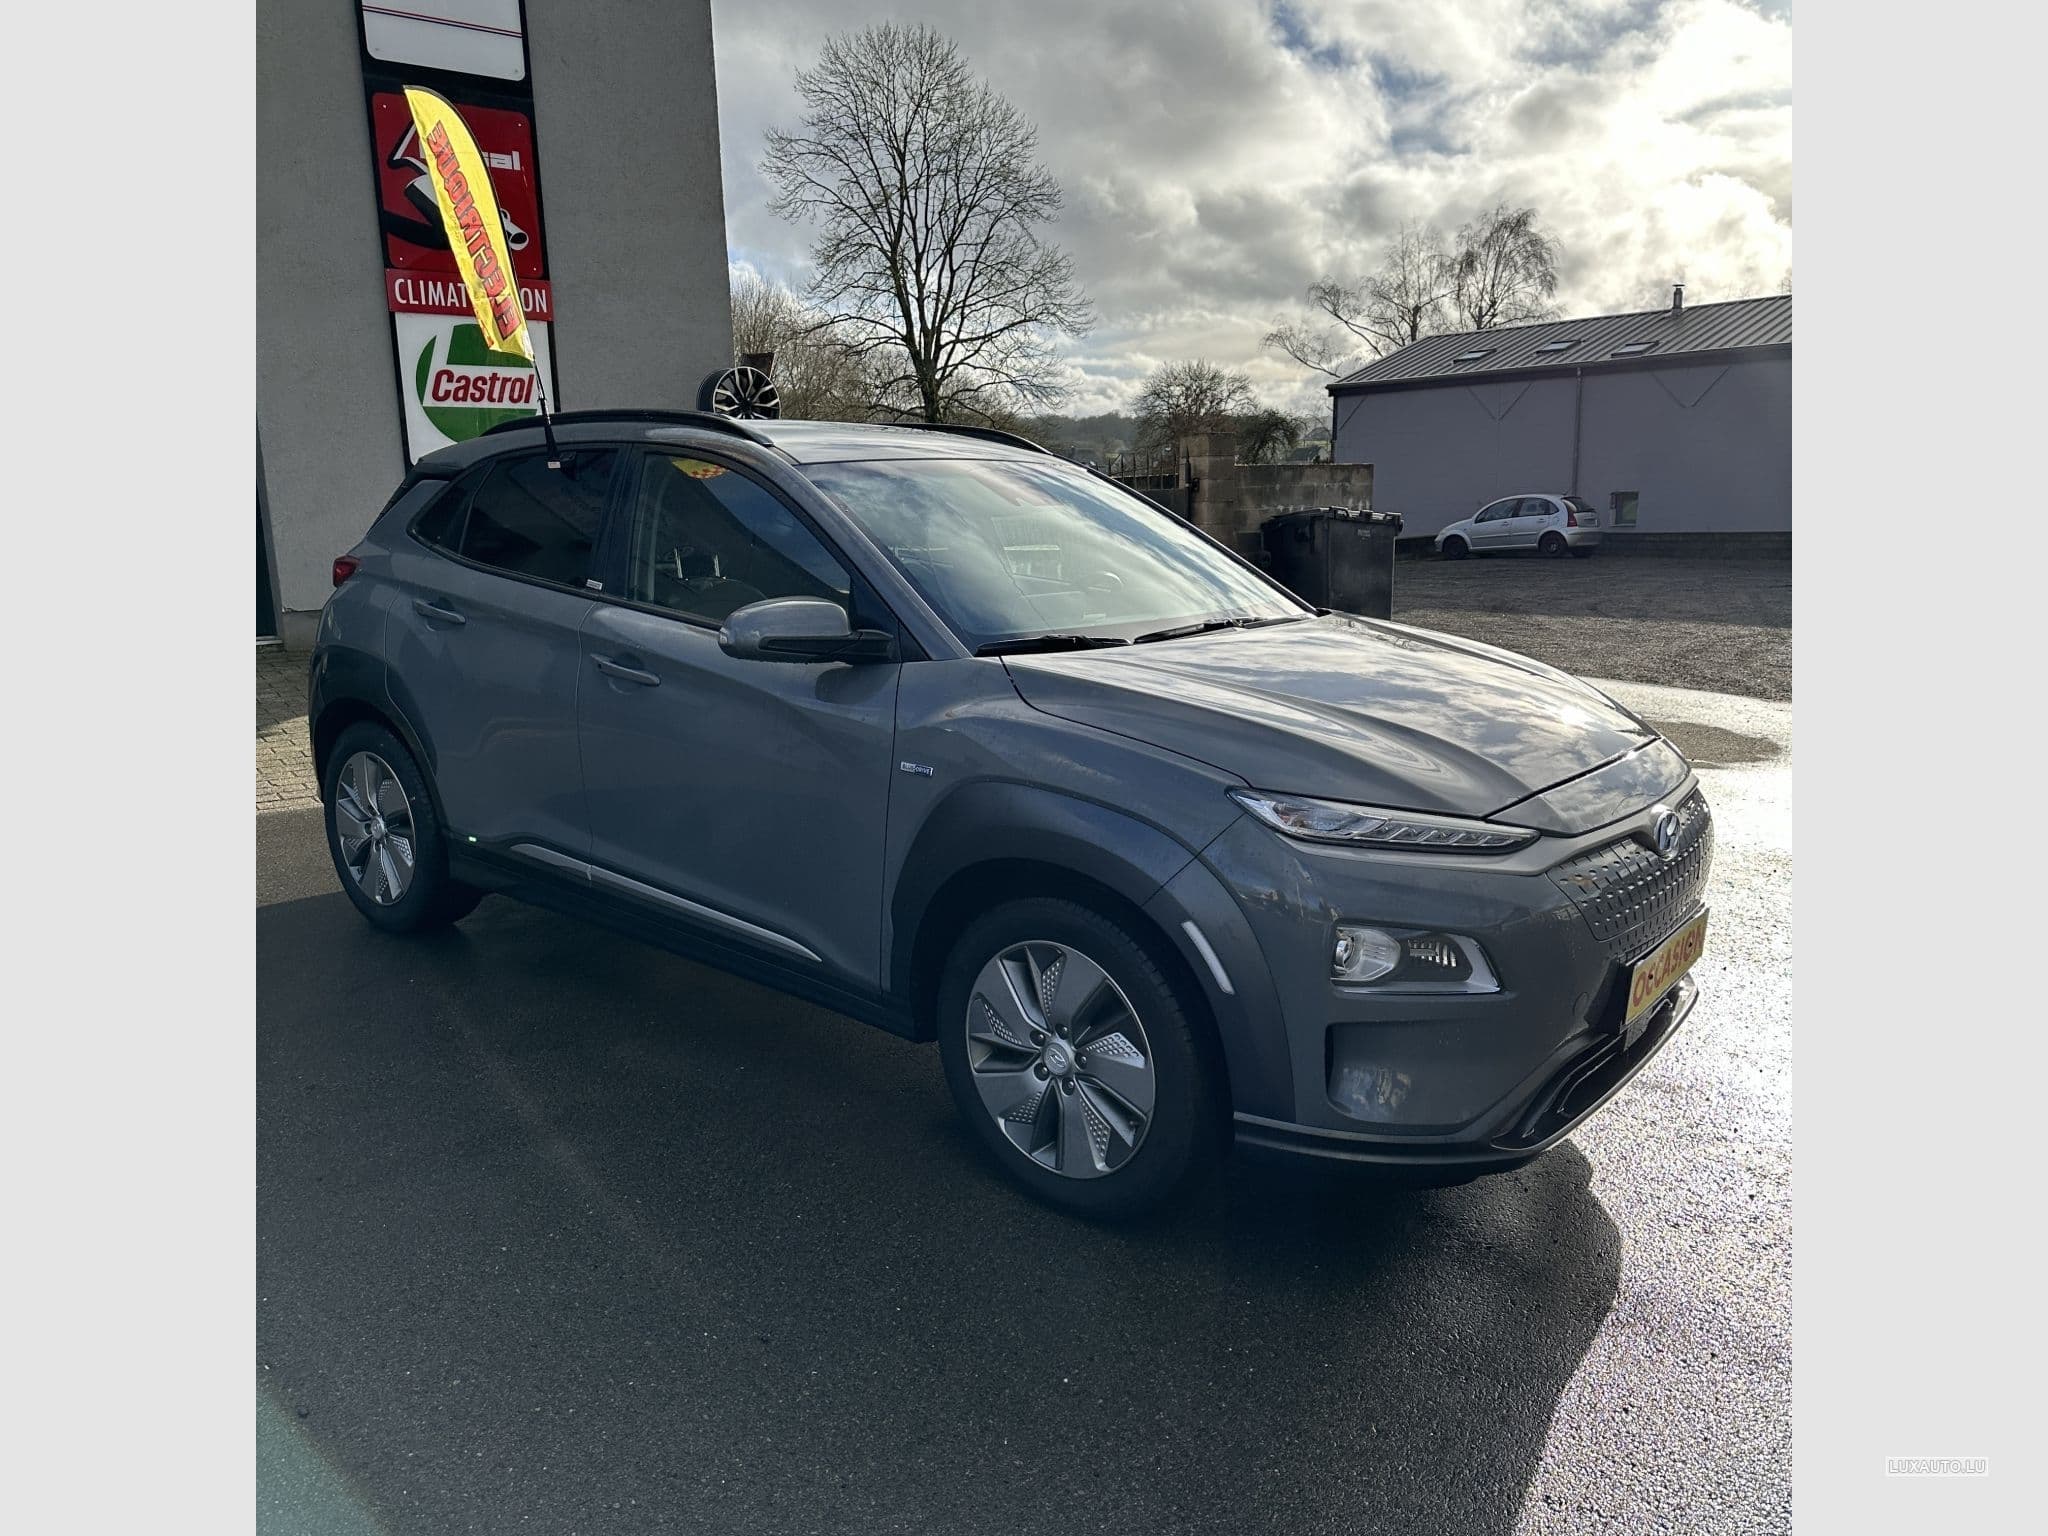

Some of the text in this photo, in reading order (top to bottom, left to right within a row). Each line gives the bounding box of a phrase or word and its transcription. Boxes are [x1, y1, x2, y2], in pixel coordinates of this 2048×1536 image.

[394, 278, 548, 314] CLIMATON
[431, 368, 535, 405] Castrol
[1632, 923, 1704, 1008] OCCASION
